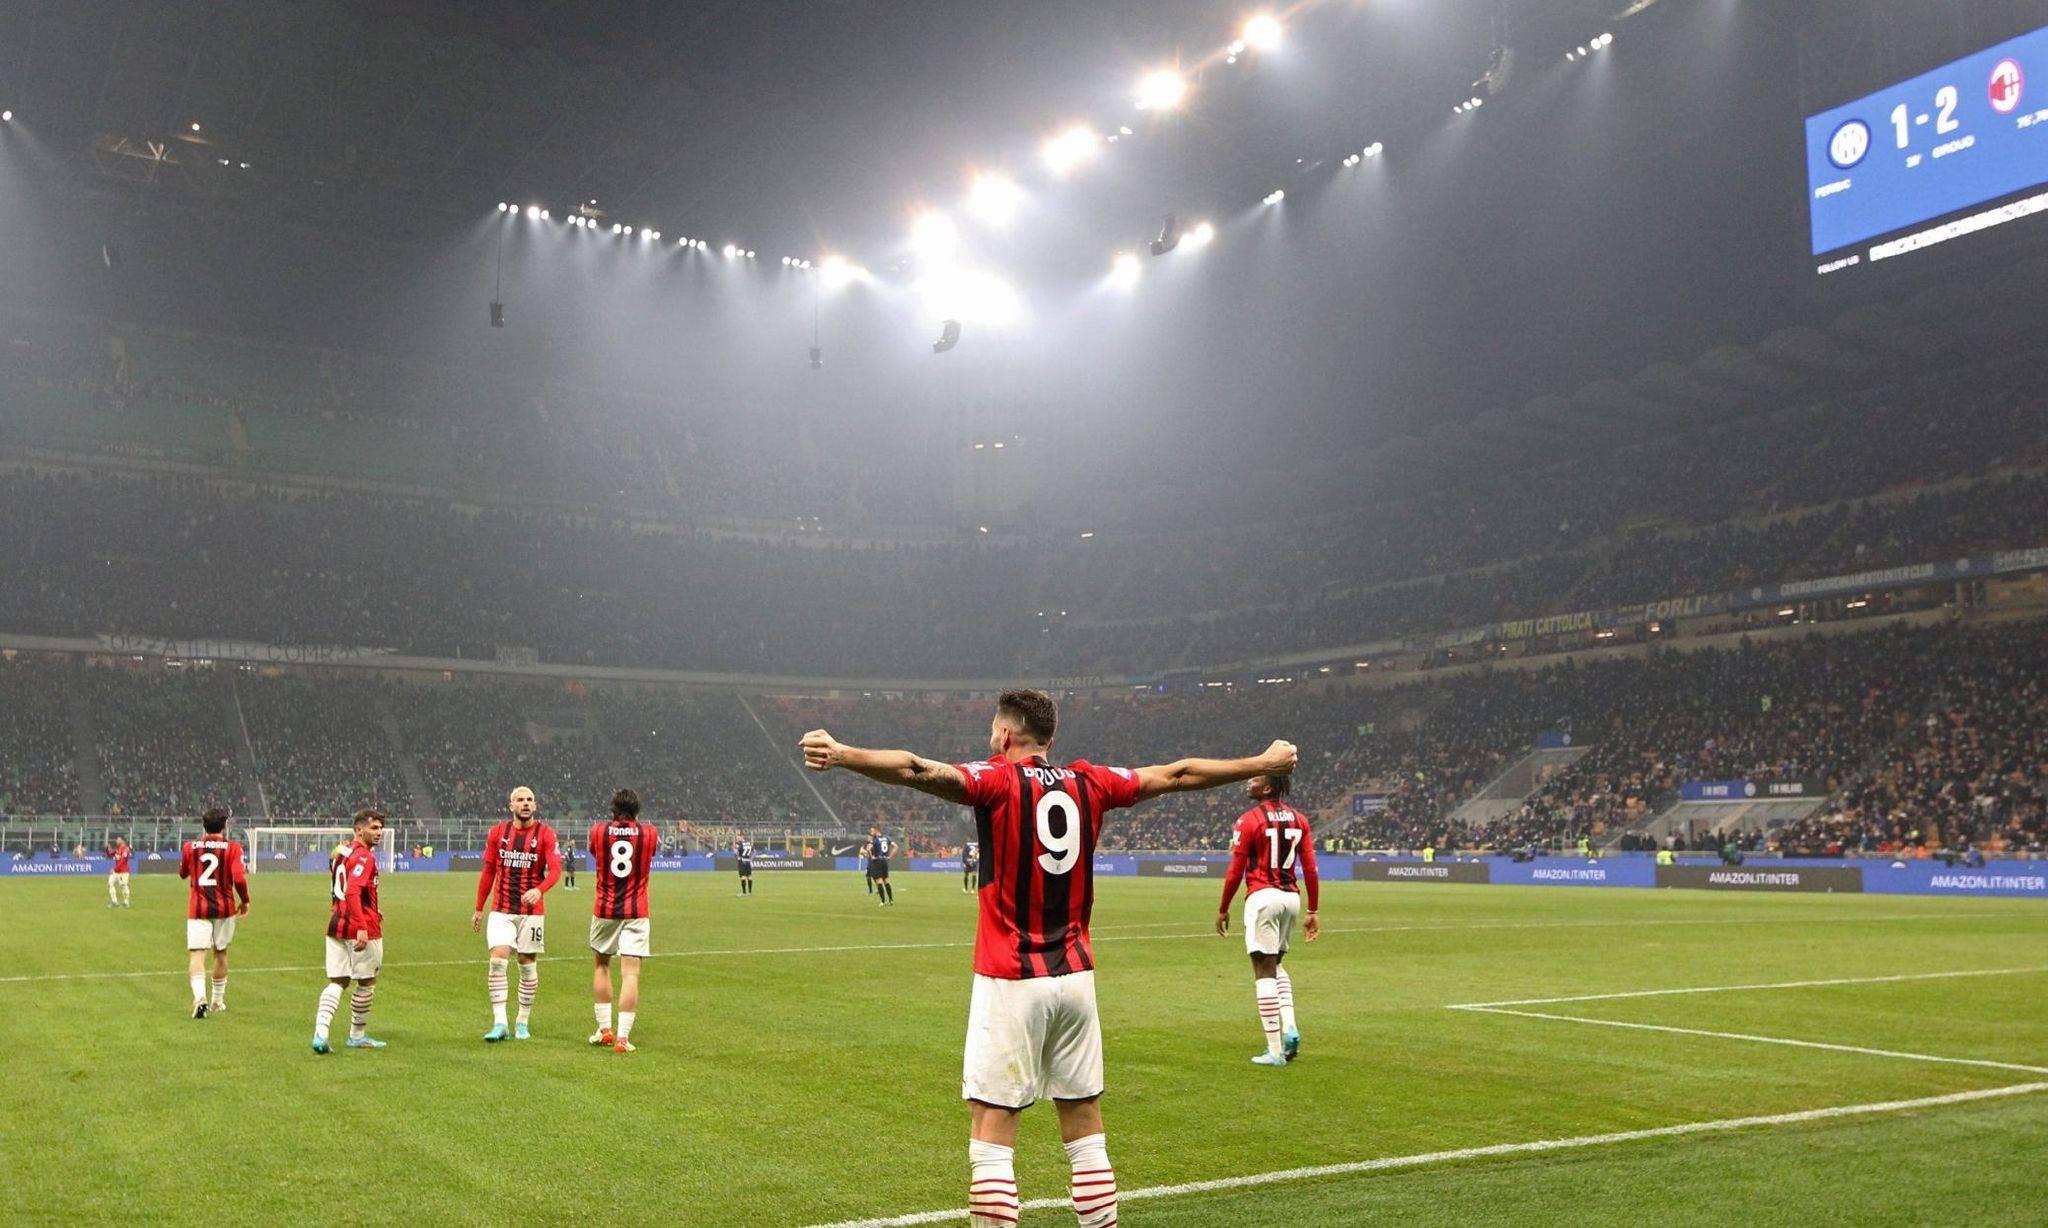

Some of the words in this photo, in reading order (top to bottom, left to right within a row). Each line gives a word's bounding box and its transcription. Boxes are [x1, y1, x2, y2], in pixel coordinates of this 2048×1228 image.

[1817, 258, 1847, 274] FOLLOW
[1847, 255, 1859, 266] US
[1536, 611, 1592, 636] CATTOLICA
[608, 826, 639, 836] TONALI
[1036, 790, 1081, 875] 9
[191, 841, 229, 850] CALABRIA
[1265, 828, 1303, 869] 17
[499, 849, 539, 862] Emirates
[610, 840, 634, 878] 8
[11, 863, 92, 873] AMAZON.IT/INTER
[198, 853, 219, 886] 2
[512, 860, 532, 869] BETTER
[1388, 866, 1449, 878] AMAZON.IT/INTER
[1532, 869, 1606, 881] AMAZON.IT/INTER
[1709, 871, 1800, 886] AMAZON.IT/INTER
[1930, 875, 2046, 890] AMAZON.IT/INTER
[530, 927, 543, 942] 19
